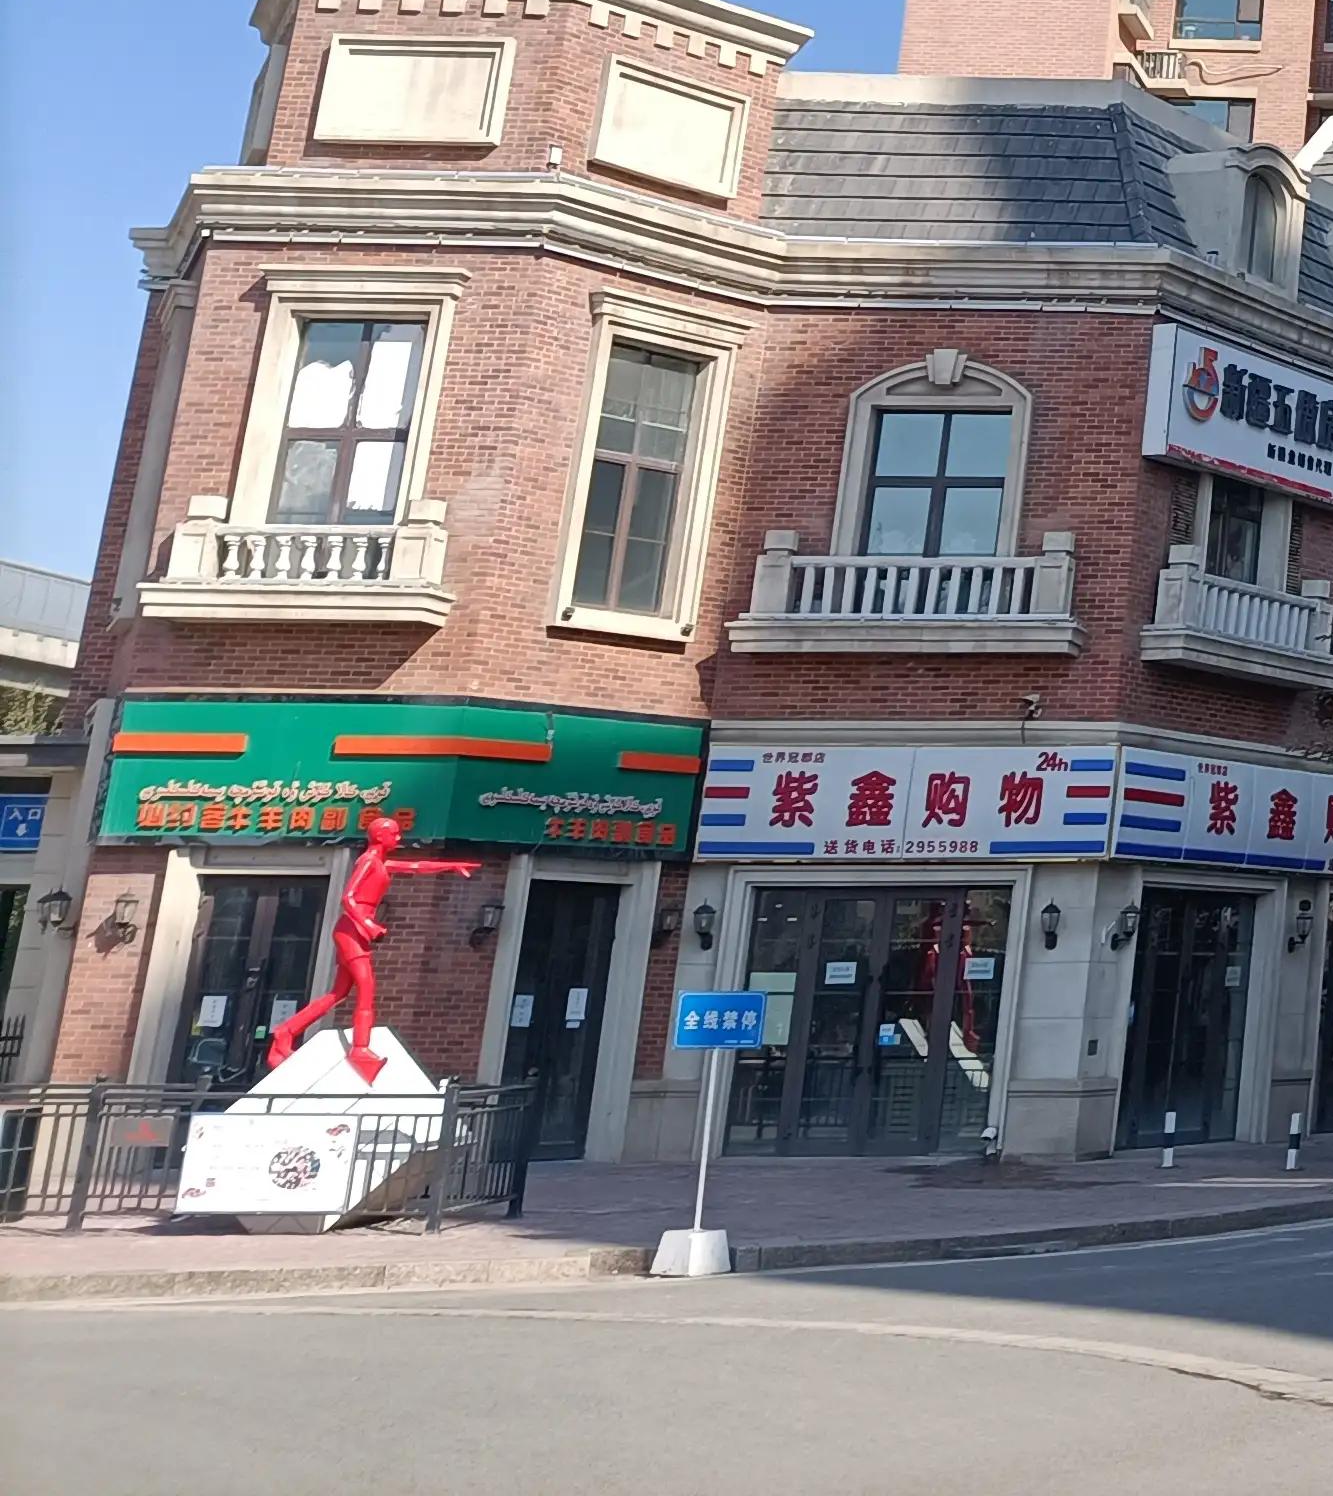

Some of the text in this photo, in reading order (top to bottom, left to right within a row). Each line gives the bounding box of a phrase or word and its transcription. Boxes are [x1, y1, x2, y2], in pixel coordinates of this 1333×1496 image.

[1036, 752, 1069, 772] 24h
[768, 770, 1044, 829] 紫鑫购物
[9, 807, 41, 820] 入口
[683, 1009, 758, 1031] 全线禁停
